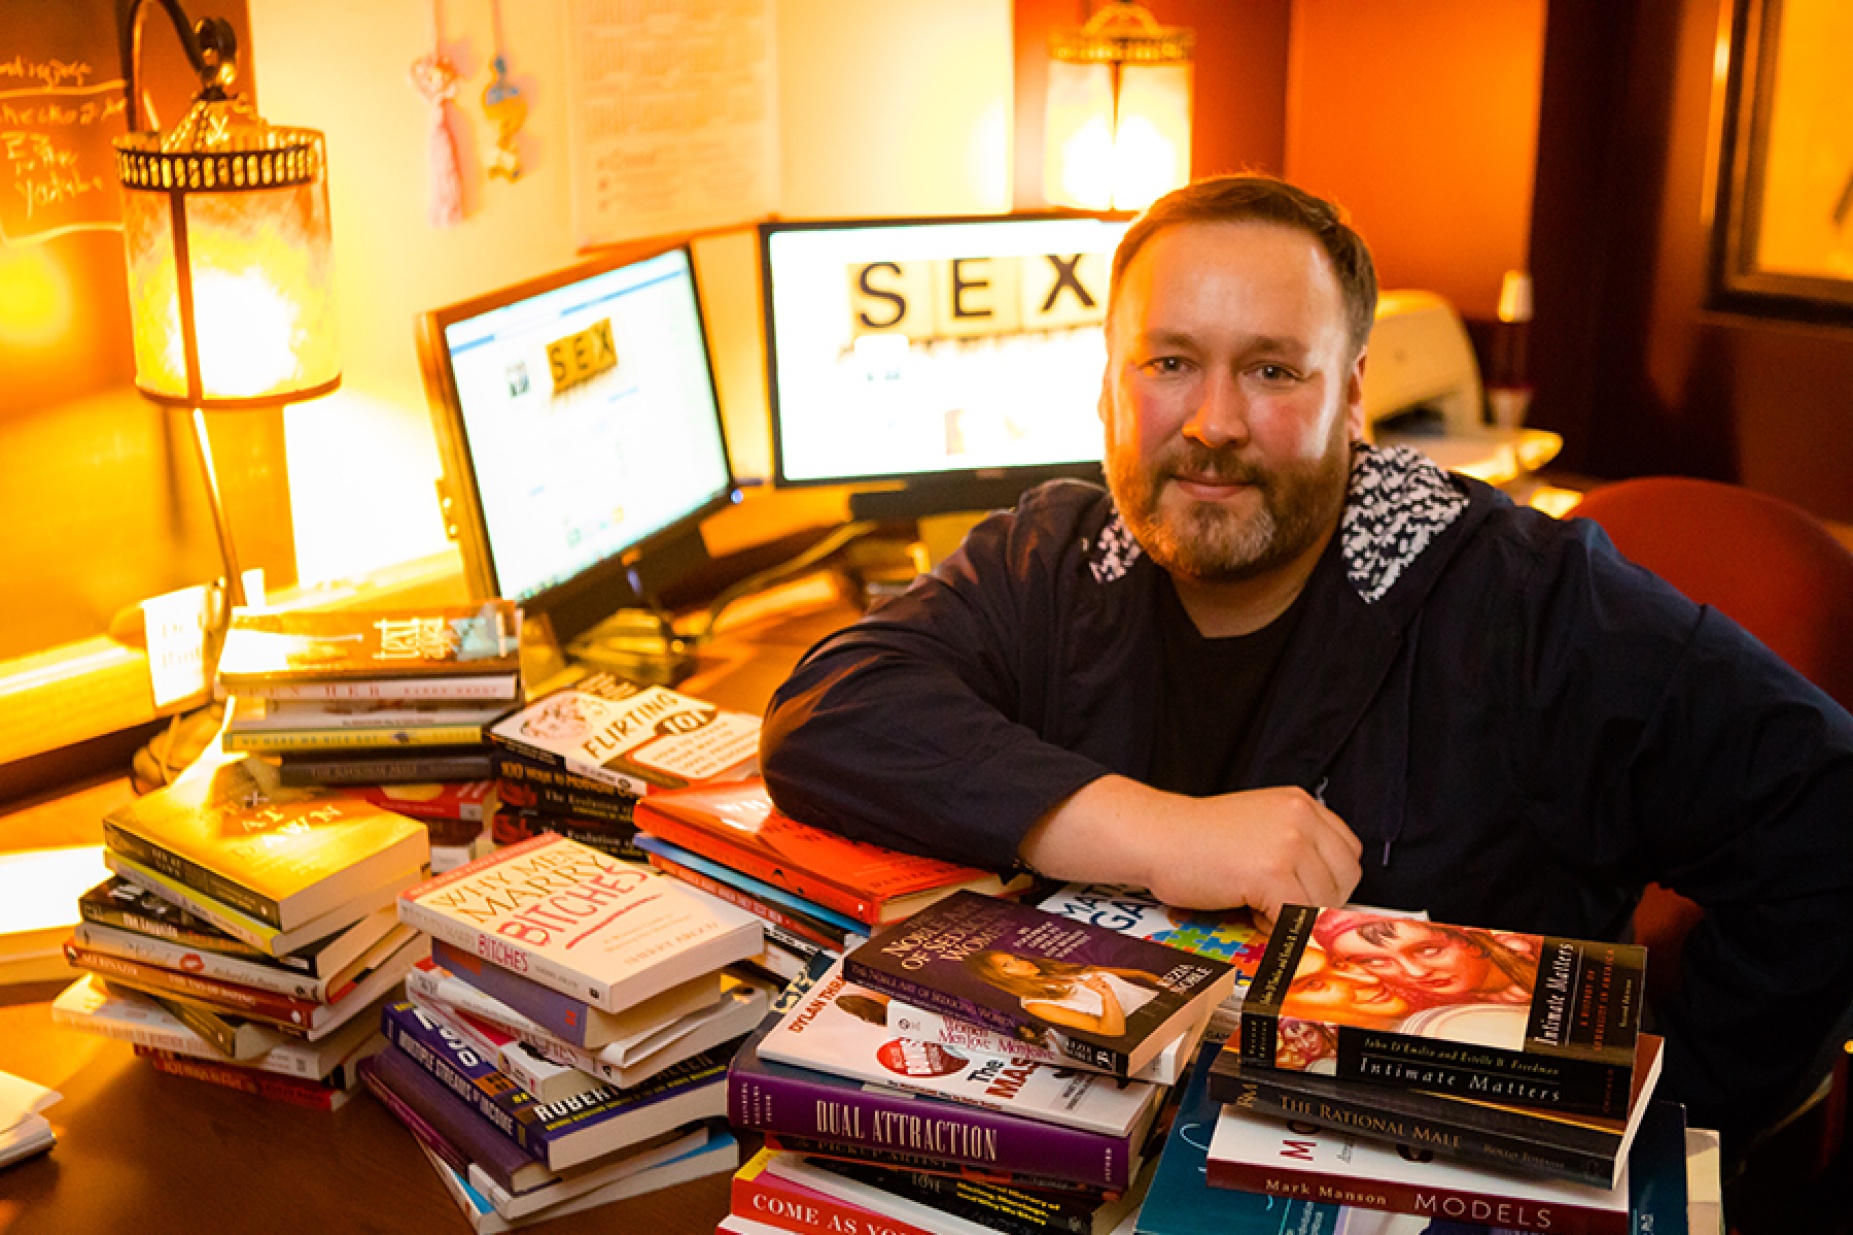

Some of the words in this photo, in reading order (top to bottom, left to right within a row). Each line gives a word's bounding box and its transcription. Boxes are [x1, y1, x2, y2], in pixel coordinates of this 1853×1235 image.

[859, 252, 1096, 329] SEX
[551, 328, 613, 382] SEX
[582, 692, 678, 759] FLIRTING
[662, 708, 710, 736] 101
[430, 871, 512, 907] WHY
[512, 845, 586, 878] MEN
[455, 854, 608, 924] MARRY
[496, 864, 649, 947] BITCHES
[477, 933, 528, 973] BITCHES
[1546, 943, 1574, 993] Matters
[788, 999, 827, 1034] DYLAN
[1534, 993, 1566, 1047] Intimate
[966, 1059, 1006, 1083] The
[1360, 1057, 1457, 1087] Intimate
[1468, 1073, 1560, 1102] Matters
[1364, 1037, 1388, 1050] John
[1391, 1040, 1437, 1058] D'Emilio
[1437, 1050, 1459, 1062] and
[1460, 1051, 1492, 1066] Estelle
[1511, 1059, 1560, 1076] Freedman
[479, 1095, 514, 1137] INCOME
[816, 1099, 866, 1140] DUAL
[872, 1109, 998, 1163] ATTRACTION
[1280, 1095, 1313, 1116] THE
[1319, 1103, 1407, 1138] RATIONAL
[1412, 1125, 1463, 1149] MALE
[753, 1193, 820, 1227] COME
[827, 1213, 858, 1235] AS
[1265, 1178, 1310, 1195] Mark
[1319, 1186, 1388, 1206] Manson
[1413, 1192, 1552, 1230] MODELS
